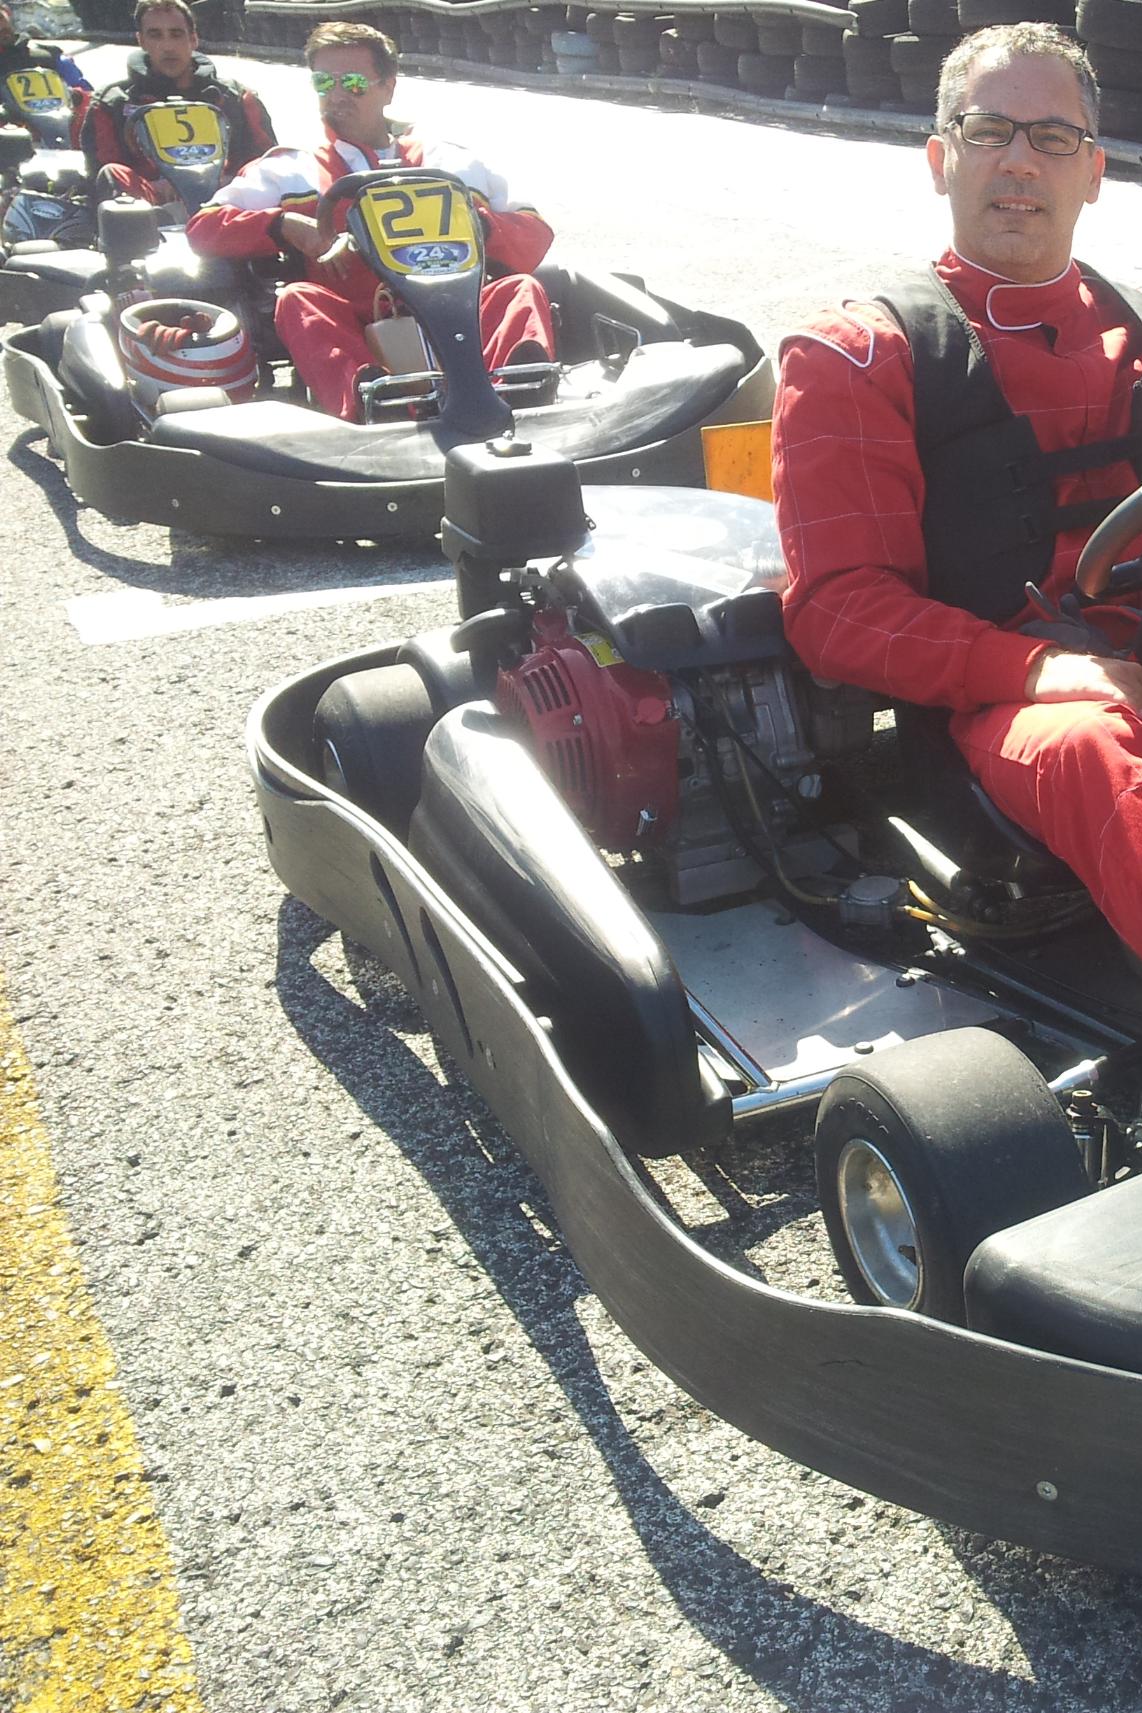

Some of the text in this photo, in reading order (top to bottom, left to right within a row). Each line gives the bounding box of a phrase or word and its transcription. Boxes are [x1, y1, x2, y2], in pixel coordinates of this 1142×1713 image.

[17, 74, 53, 96] 21
[174, 107, 195, 142] 5
[371, 185, 451, 239] 27
[413, 245, 445, 262] 24
